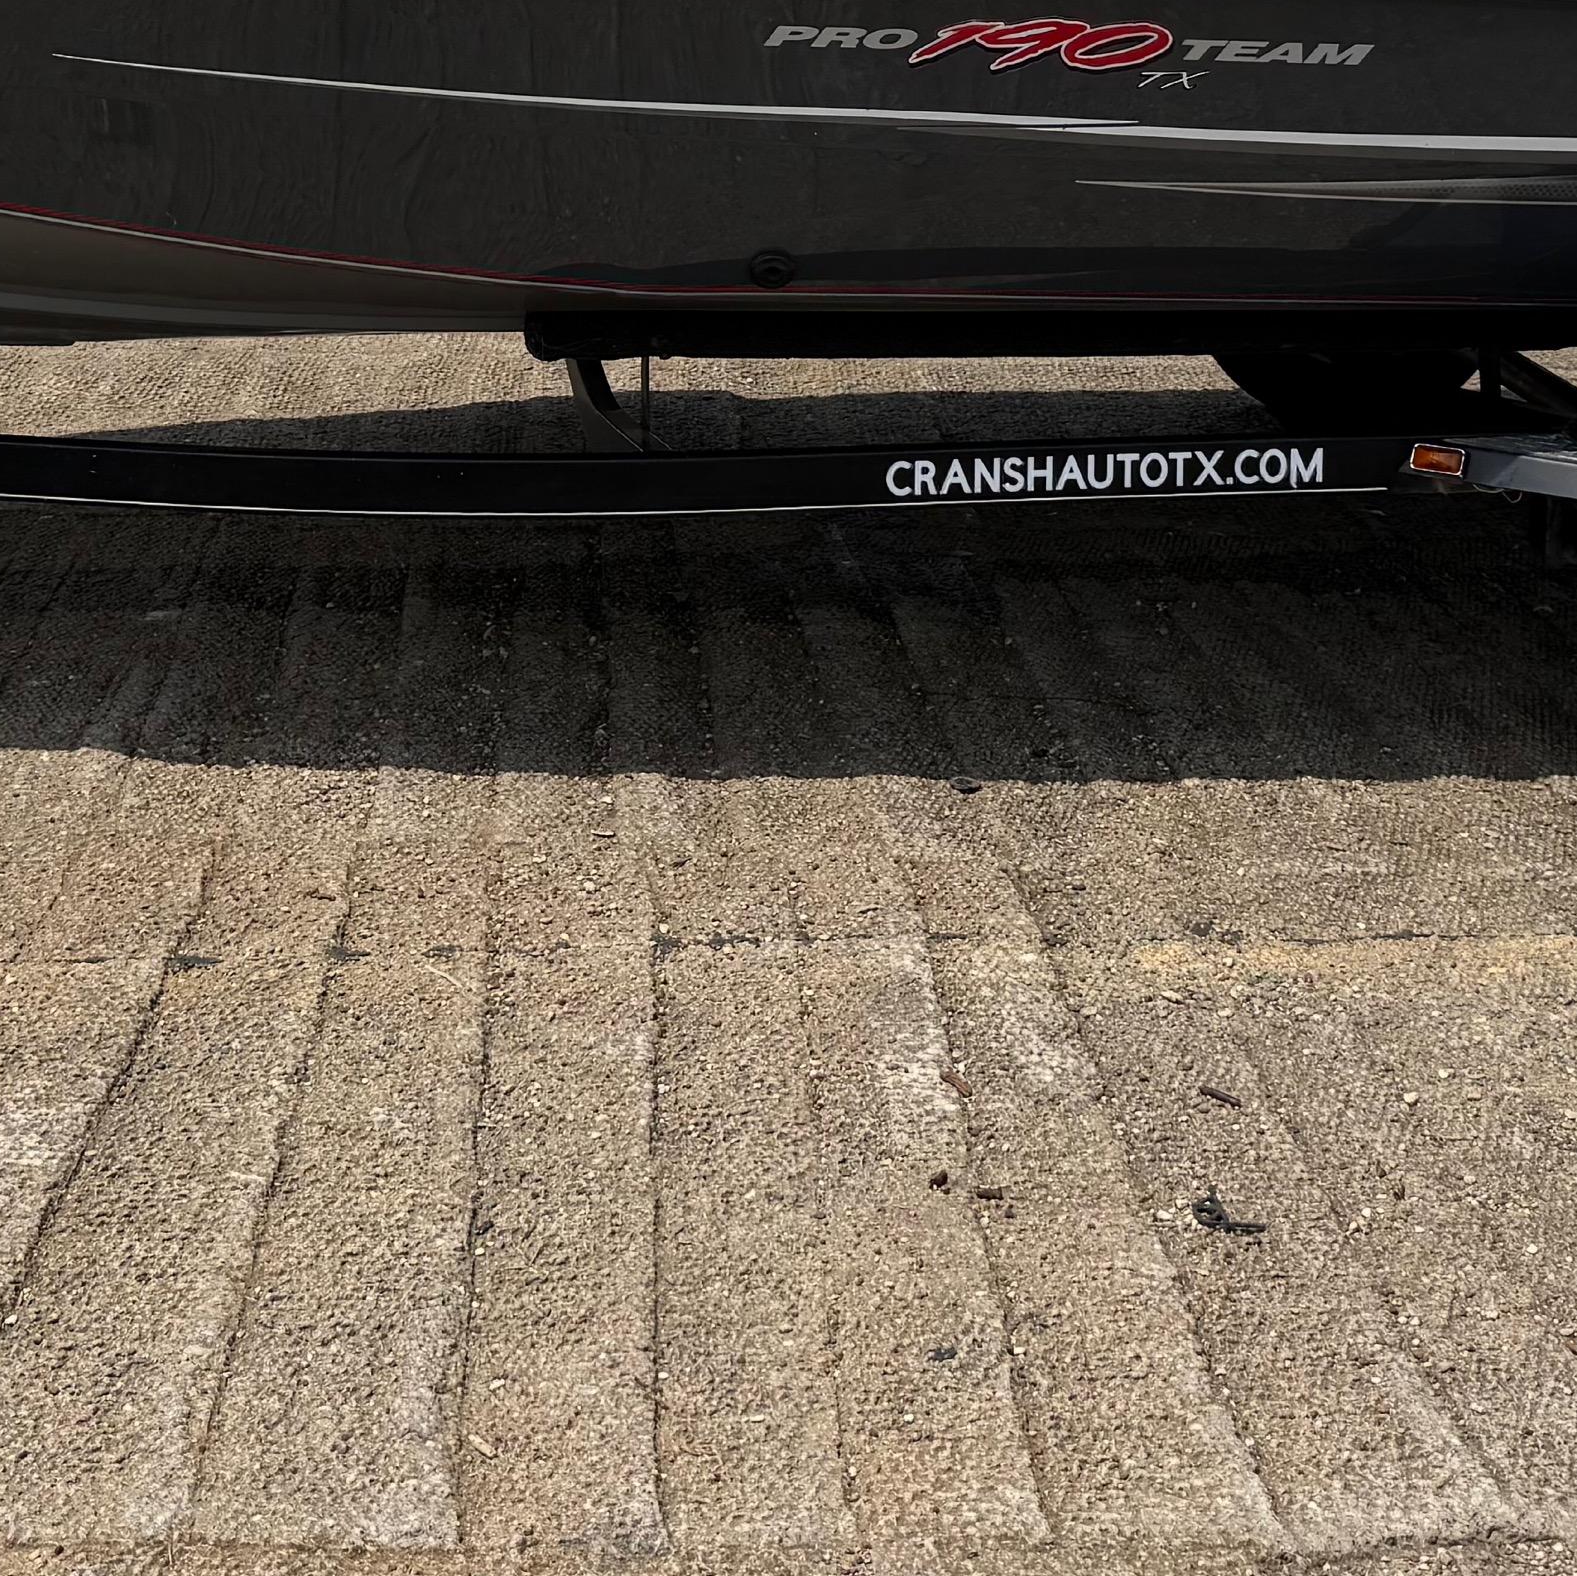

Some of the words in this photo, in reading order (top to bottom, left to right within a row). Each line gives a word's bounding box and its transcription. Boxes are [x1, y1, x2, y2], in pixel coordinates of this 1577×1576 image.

[764, 24, 919, 50] PRO
[908, 18, 1174, 71] 190
[1180, 38, 1375, 66] TEAM
[1137, 70, 1209, 90] TX
[885, 446, 1324, 497] CRANSHAUTOTX.COM
